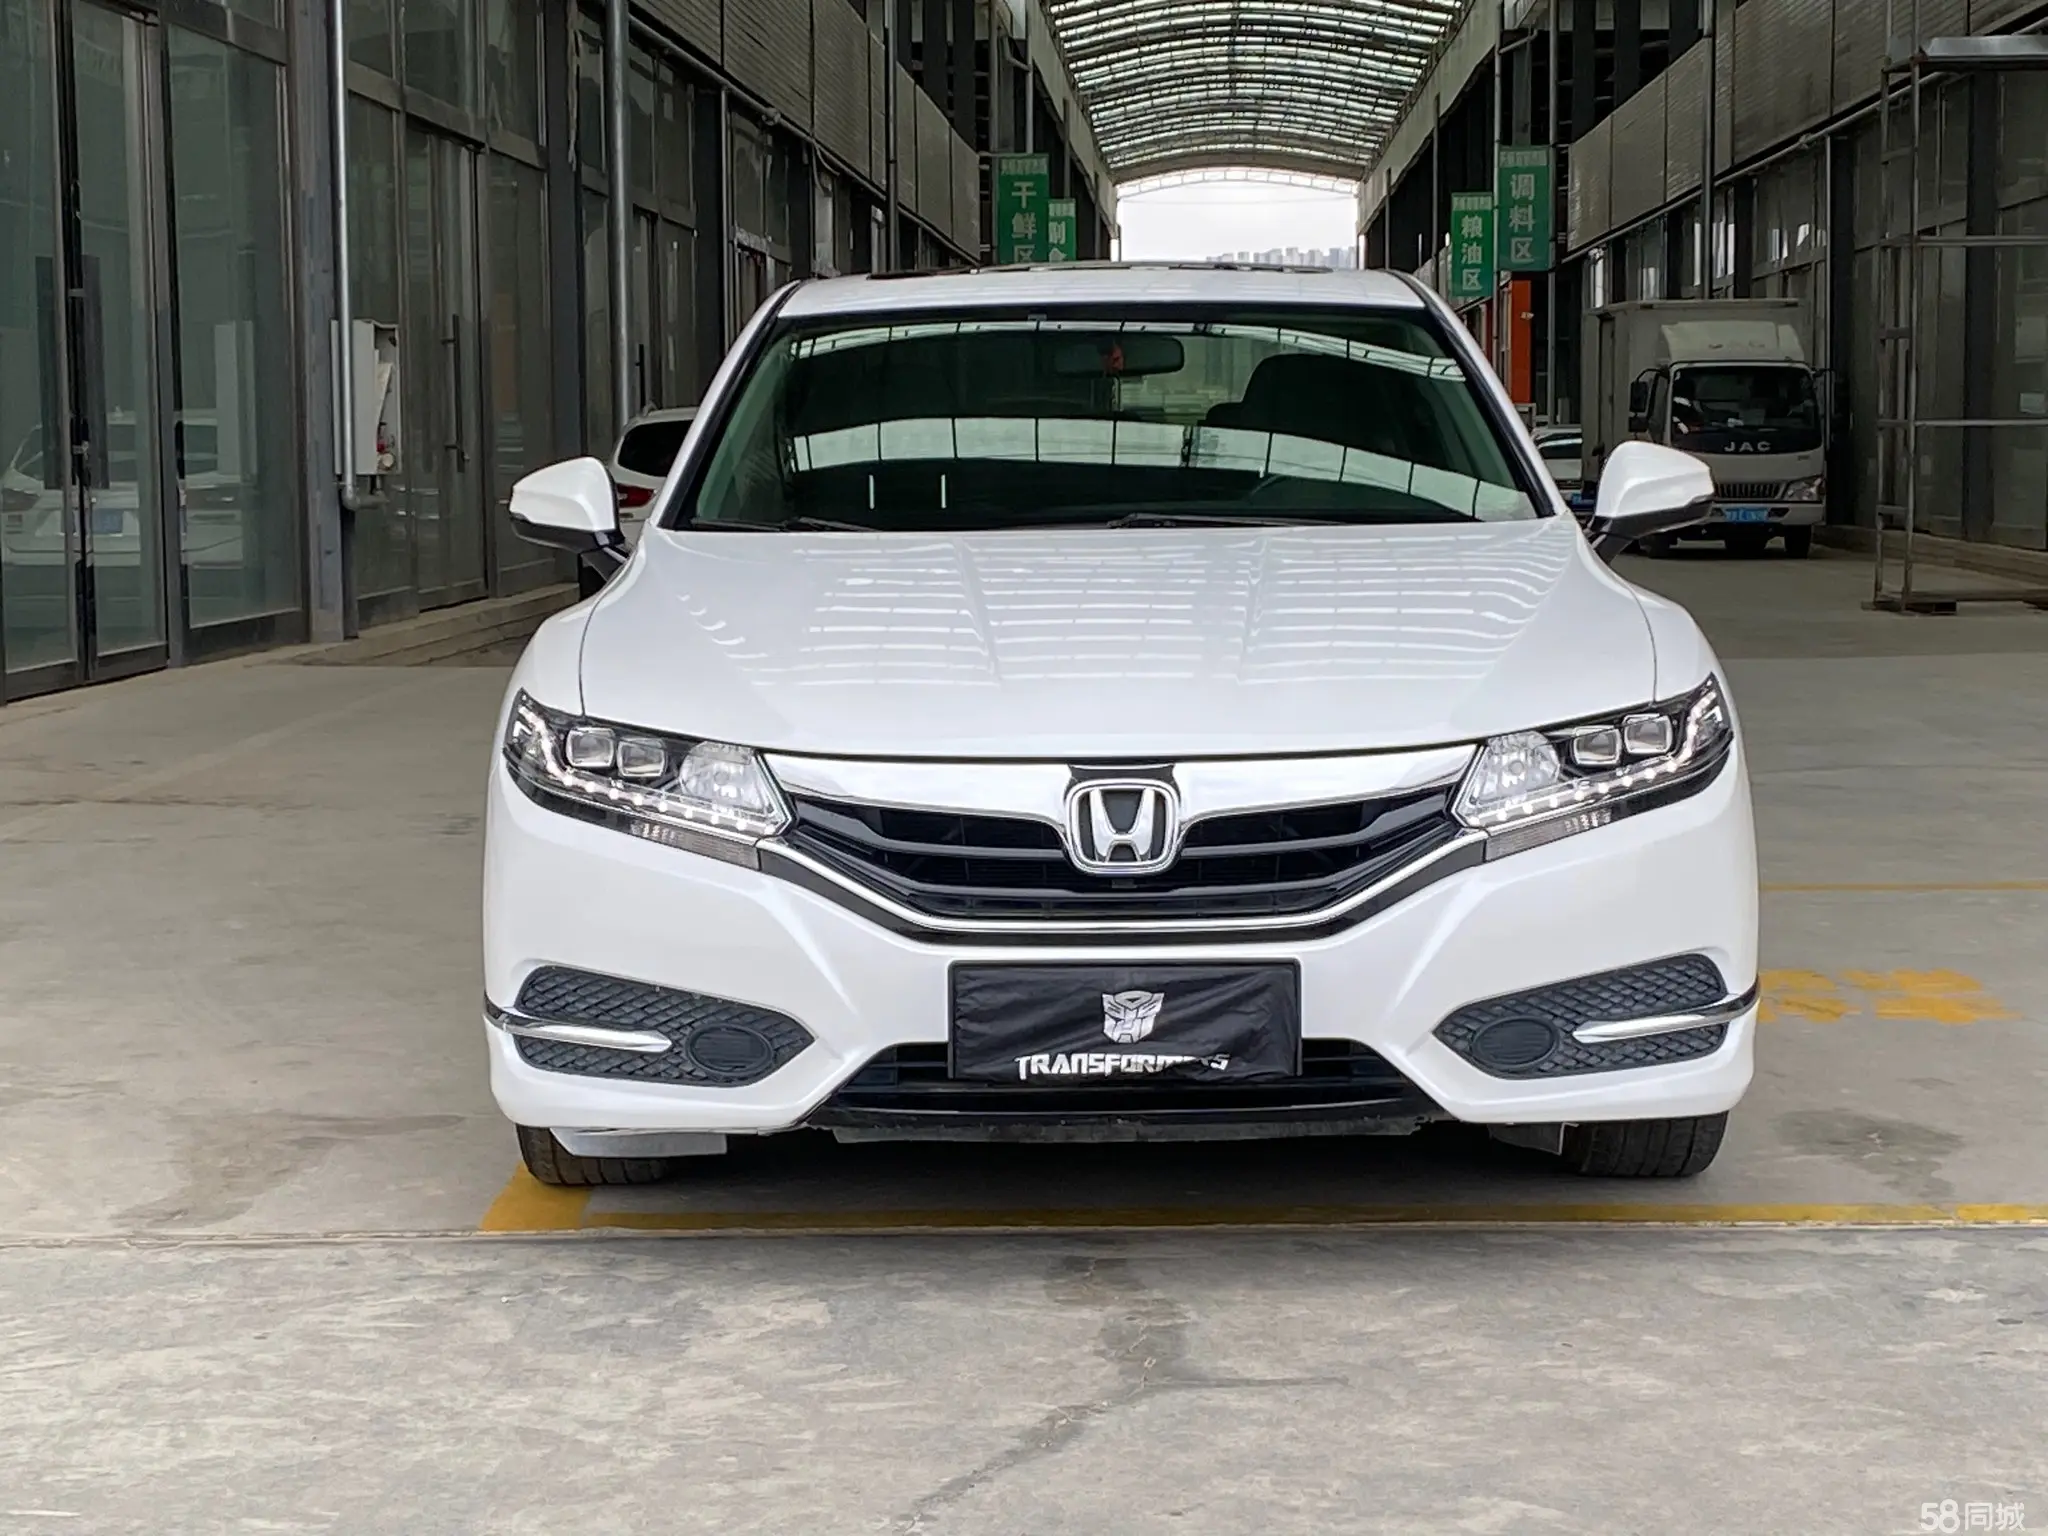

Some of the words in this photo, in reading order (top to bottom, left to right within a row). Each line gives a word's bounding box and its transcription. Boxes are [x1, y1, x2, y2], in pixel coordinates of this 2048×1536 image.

[1461, 214, 1483, 291] 粮油区
[1509, 173, 1536, 263] 调料区
[1724, 440, 1771, 452] JAC
